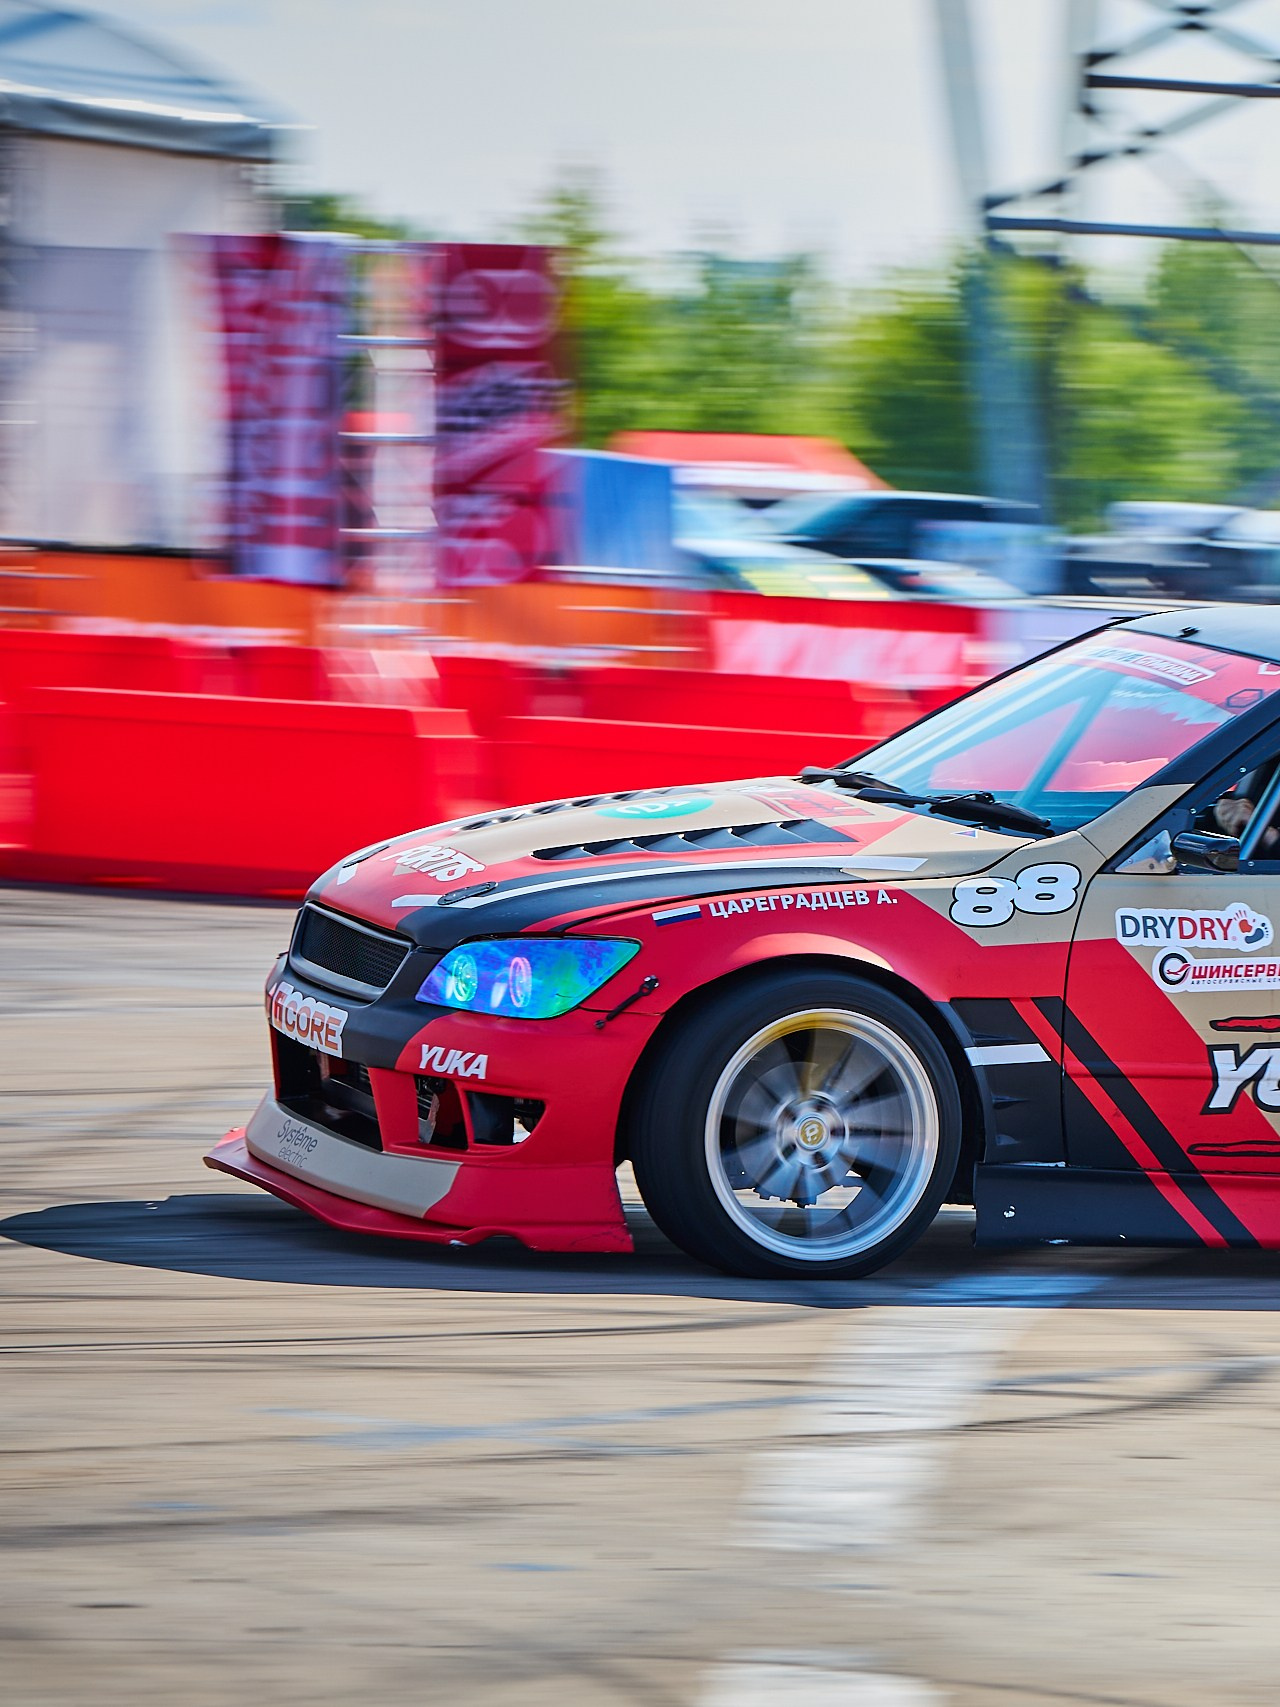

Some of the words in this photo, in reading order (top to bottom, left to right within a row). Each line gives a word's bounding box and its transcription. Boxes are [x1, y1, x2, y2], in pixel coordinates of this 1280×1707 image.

[708, 890, 870, 918] ЦАРЕГРАДЦЕВ
[877, 889, 898, 904] А.
[949, 862, 1082, 928] 88
[1121, 914, 1233, 941] DRYDRY
[419, 1044, 489, 1079] YUKA
